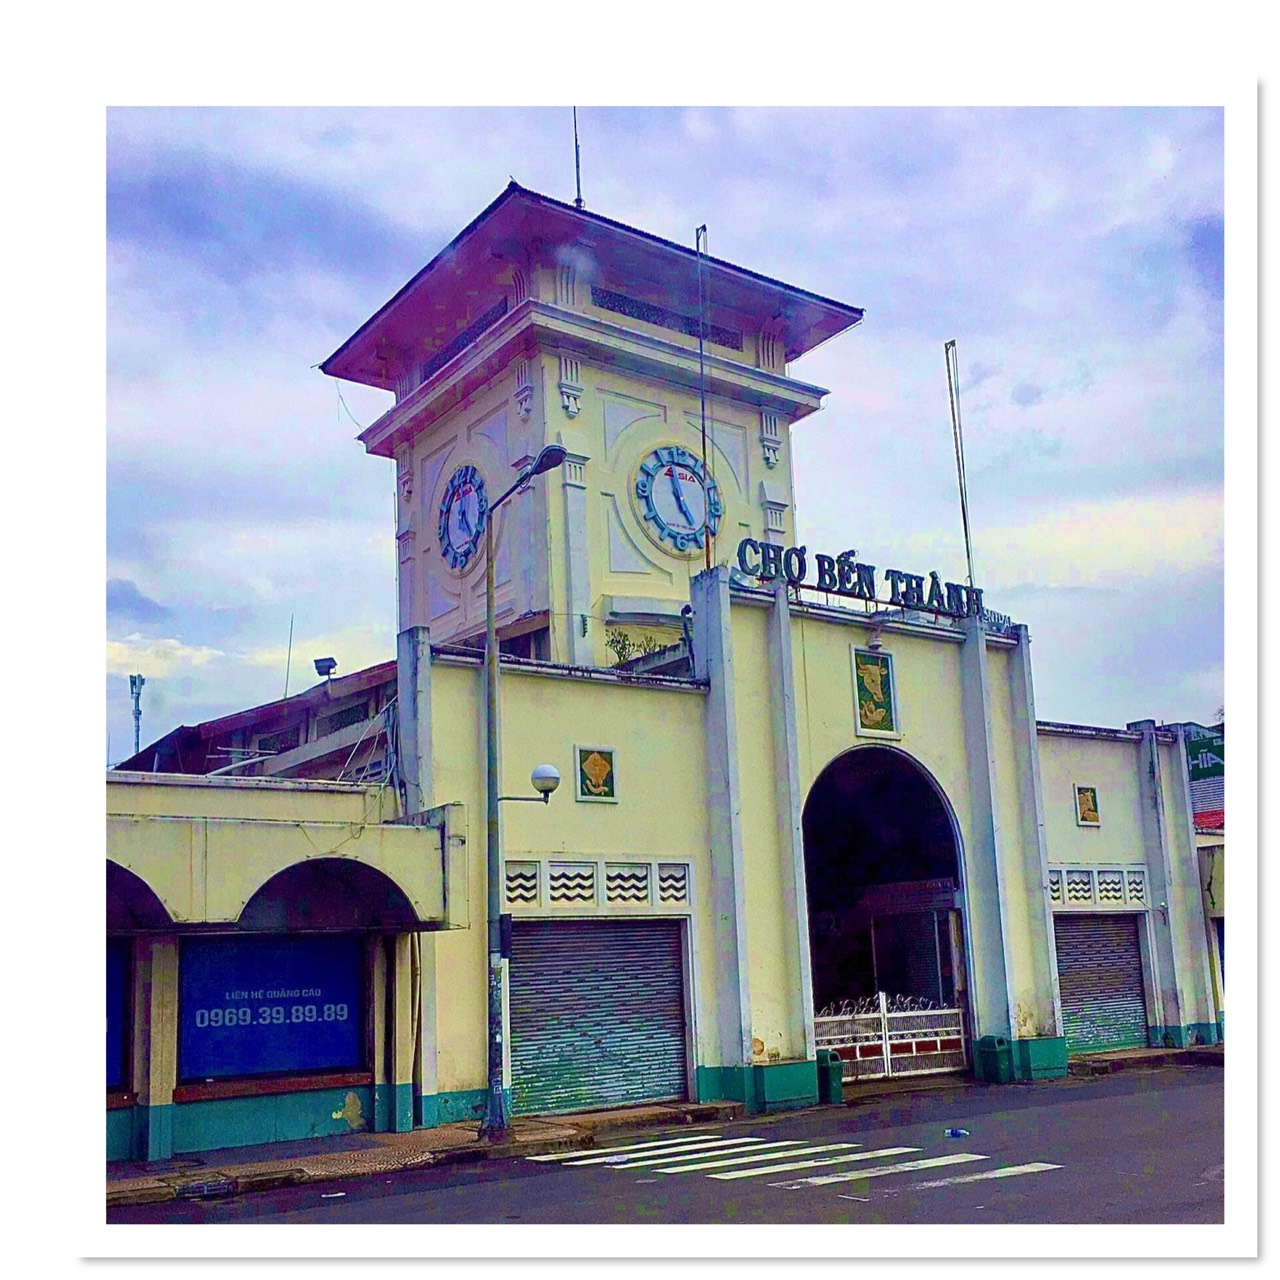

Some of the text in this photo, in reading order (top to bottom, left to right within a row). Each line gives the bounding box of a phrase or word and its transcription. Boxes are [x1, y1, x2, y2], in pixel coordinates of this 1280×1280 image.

[816, 550, 876, 599] BẾN
[885, 570, 984, 618] THÀNH
[195, 1003, 348, 1028] 0969.39.89.89
